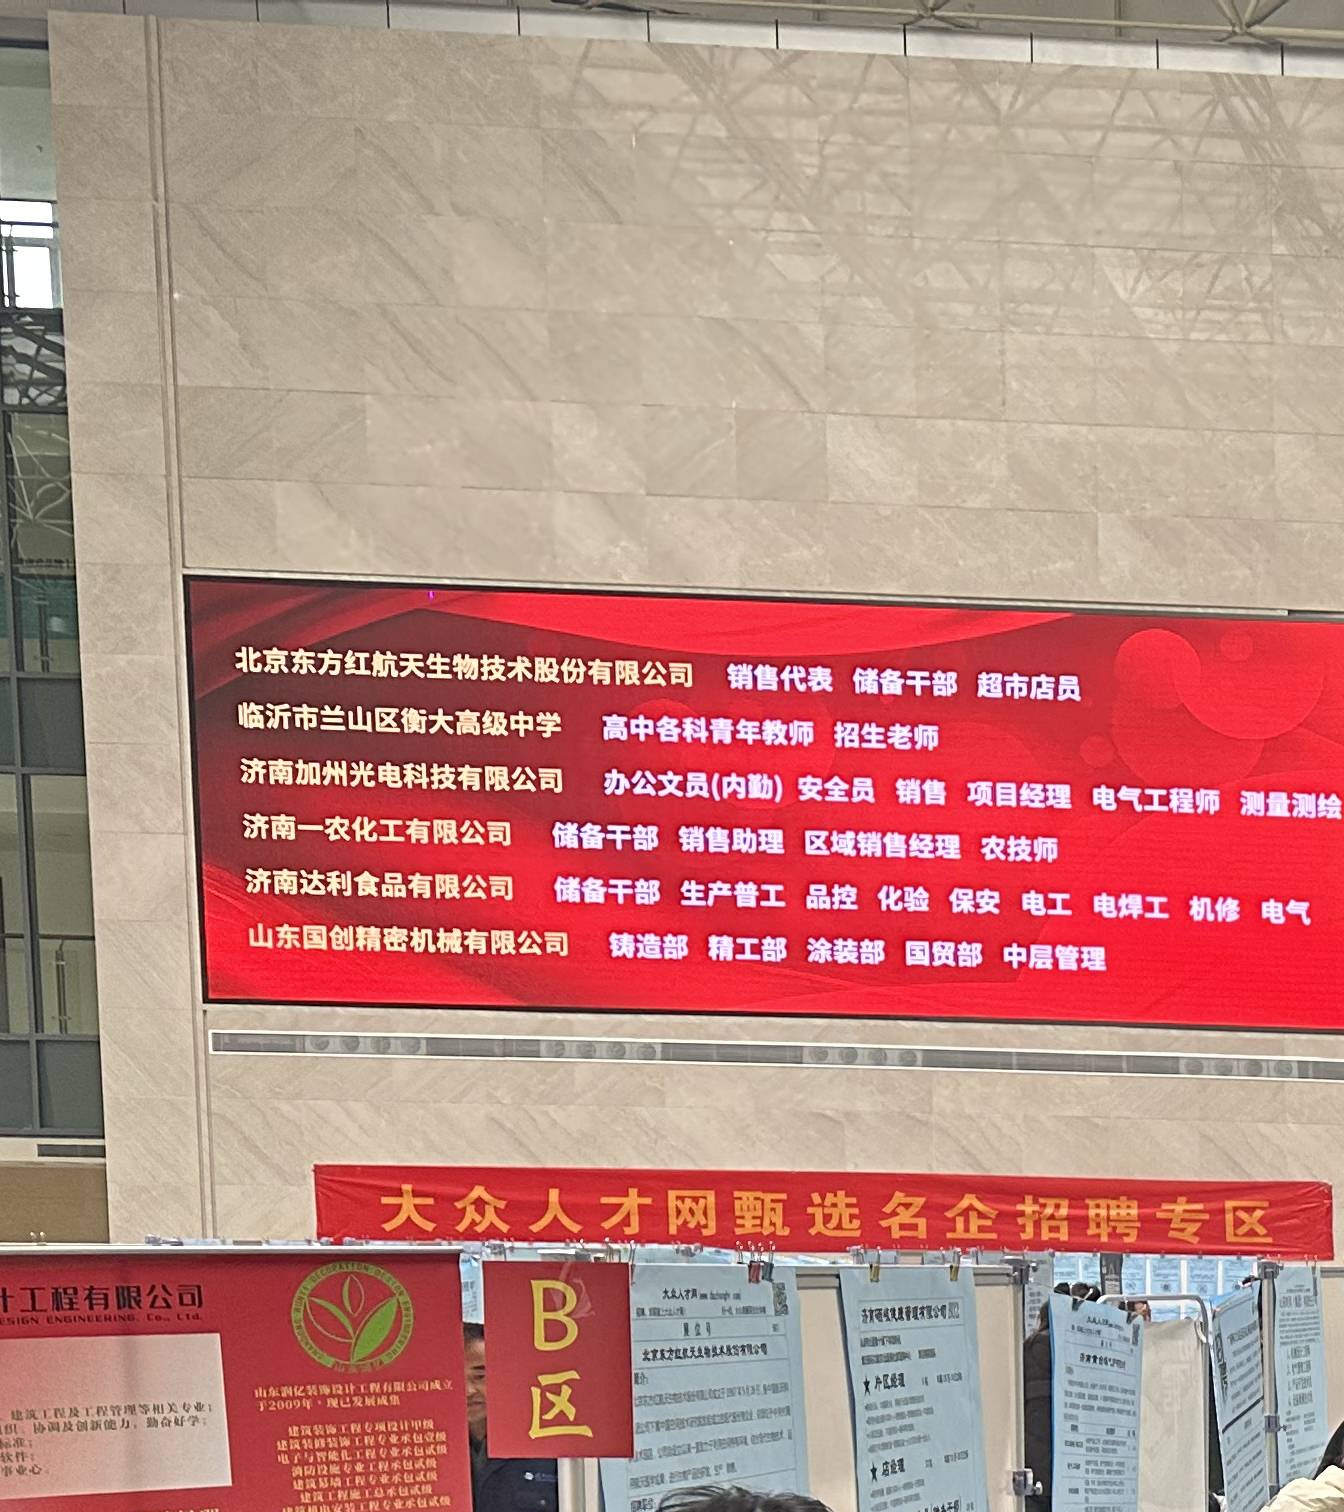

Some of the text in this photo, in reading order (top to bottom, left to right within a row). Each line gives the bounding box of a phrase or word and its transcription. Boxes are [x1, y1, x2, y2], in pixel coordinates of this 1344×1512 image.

[235, 647, 1081, 701] 北京东方红航天生物技术股份有限公司 销售代表 储备干部 超市店员
[238, 702, 938, 751] 临沂市兰山区衡大高级中学 高中各科青年教师 招生老师
[241, 758, 1342, 819] 济南加州光电科技有限公司 办公文员(内勤) 安全员 销售 项目经理 电气工程师 测量测绘
[243, 813, 1058, 862] 济南一农化工有限公司 储备干部 销售助理 区域销售经理 农技师
[245, 868, 1311, 925] 济南达利食品有限公司 储备干部 生产普工 品控 化验 保安 电工 电焊工 机修 电气
[249, 923, 1106, 971] 山东国创精密机械有限公司 铸造部 精工部 涂装部 国贸部 中层管理
[380, 1183, 1274, 1243] 大众人才网甄选名企招聘专区
[528, 1280, 594, 1440] B区
